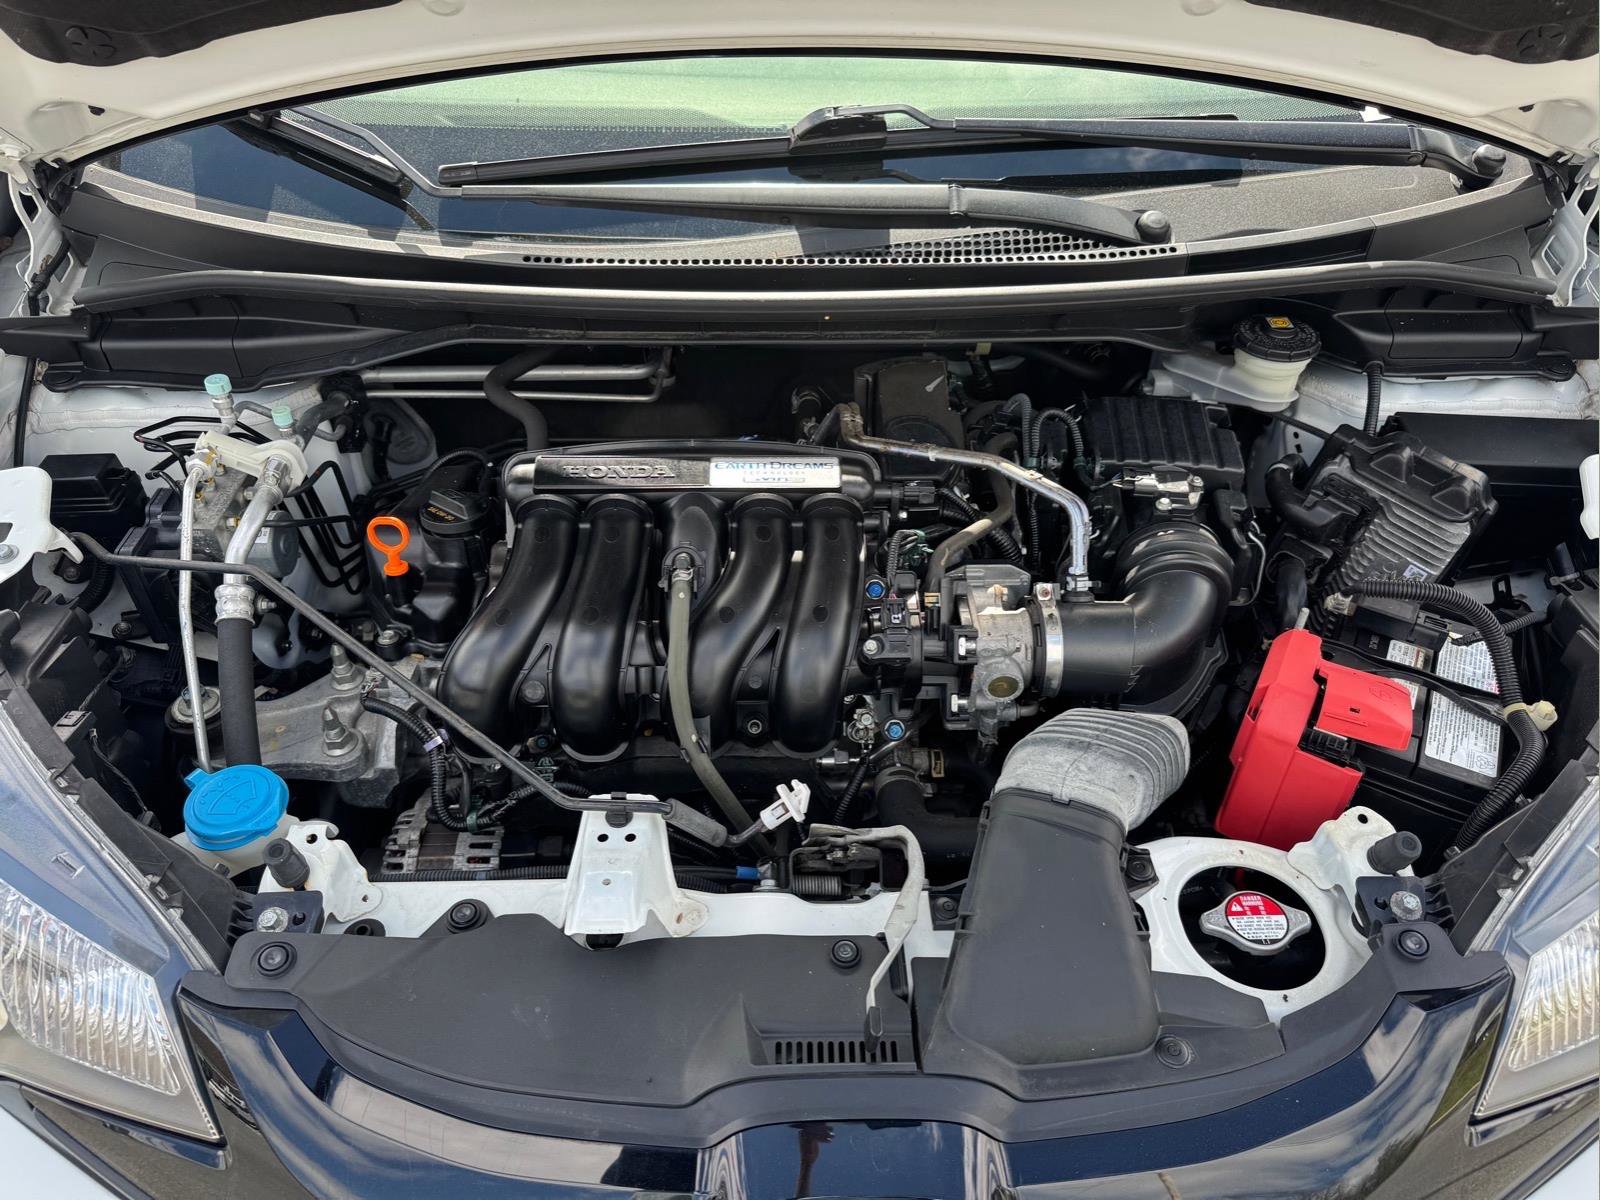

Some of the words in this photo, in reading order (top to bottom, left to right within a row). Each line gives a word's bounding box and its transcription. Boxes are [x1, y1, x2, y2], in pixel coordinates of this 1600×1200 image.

[714, 462, 767, 470] EARTH
[770, 461, 835, 470] DREAMS
[562, 465, 675, 479] HONDA
